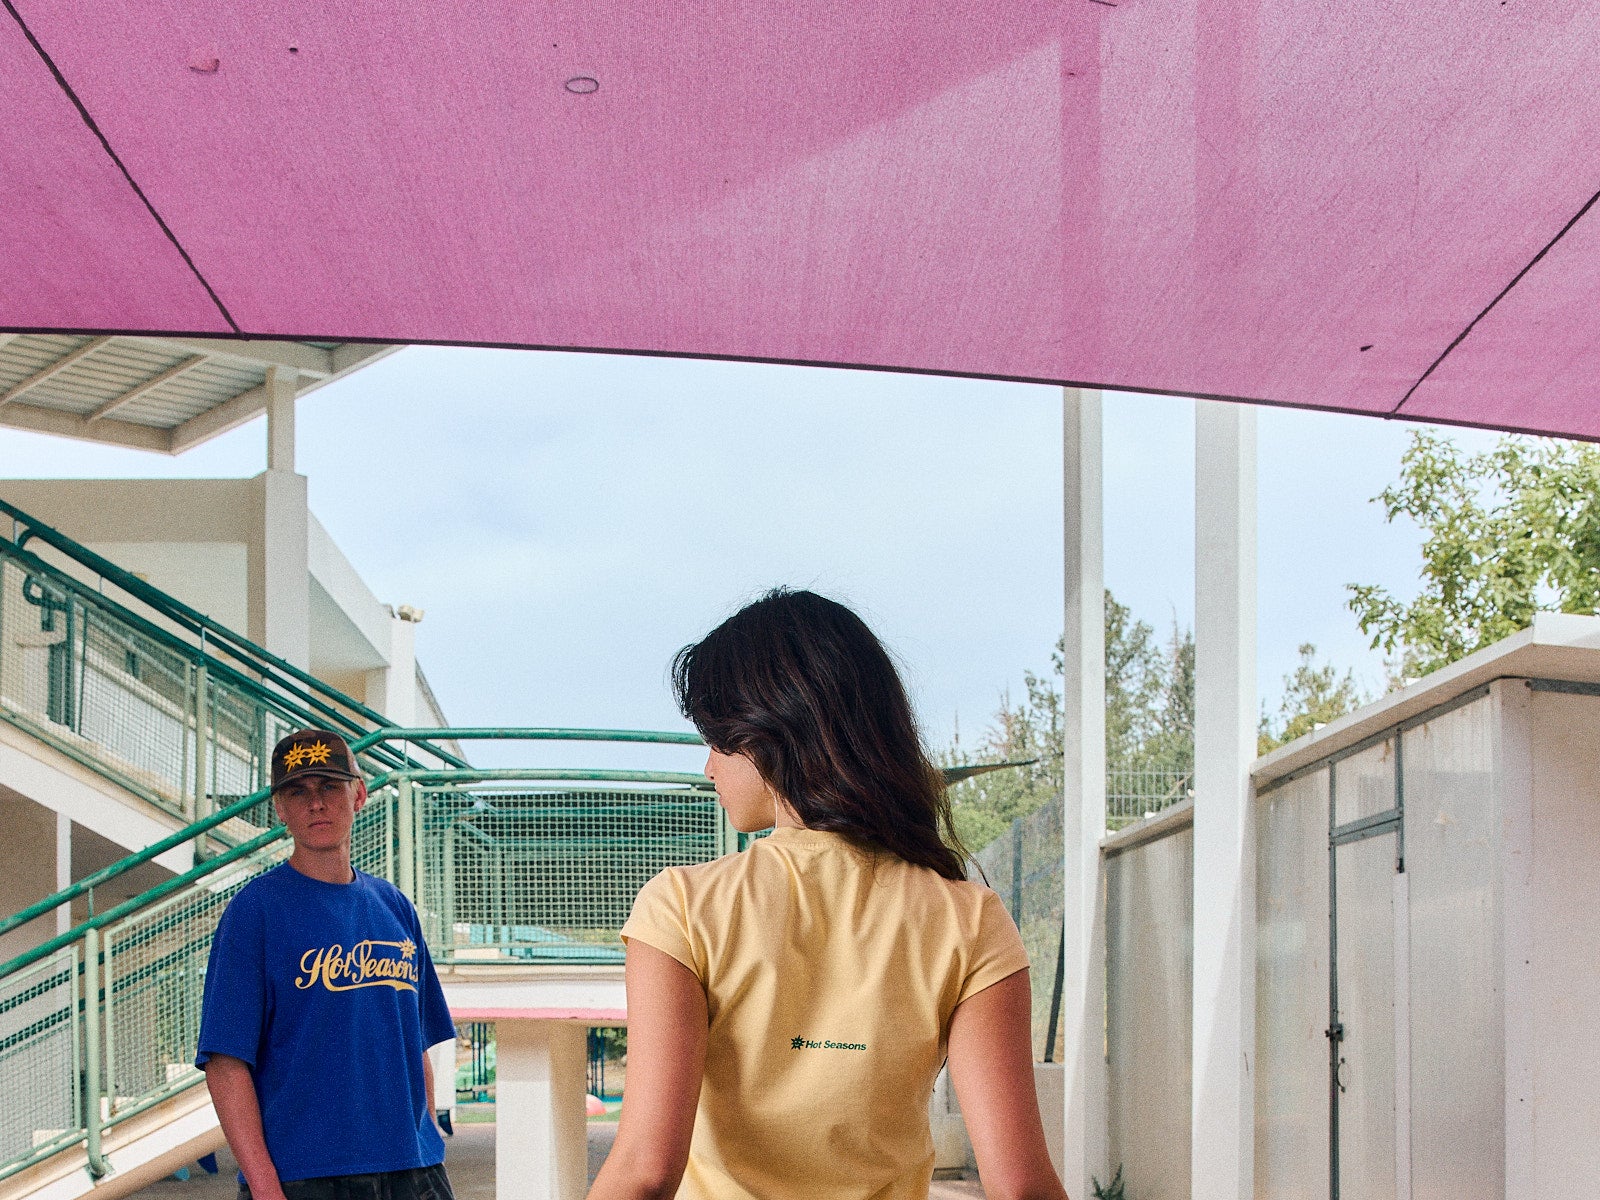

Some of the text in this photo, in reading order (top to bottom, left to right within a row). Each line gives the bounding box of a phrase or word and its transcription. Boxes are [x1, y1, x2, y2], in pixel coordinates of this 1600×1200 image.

[295, 944, 352, 991] Hot
[805, 1040, 867, 1051] Hot Seasons
